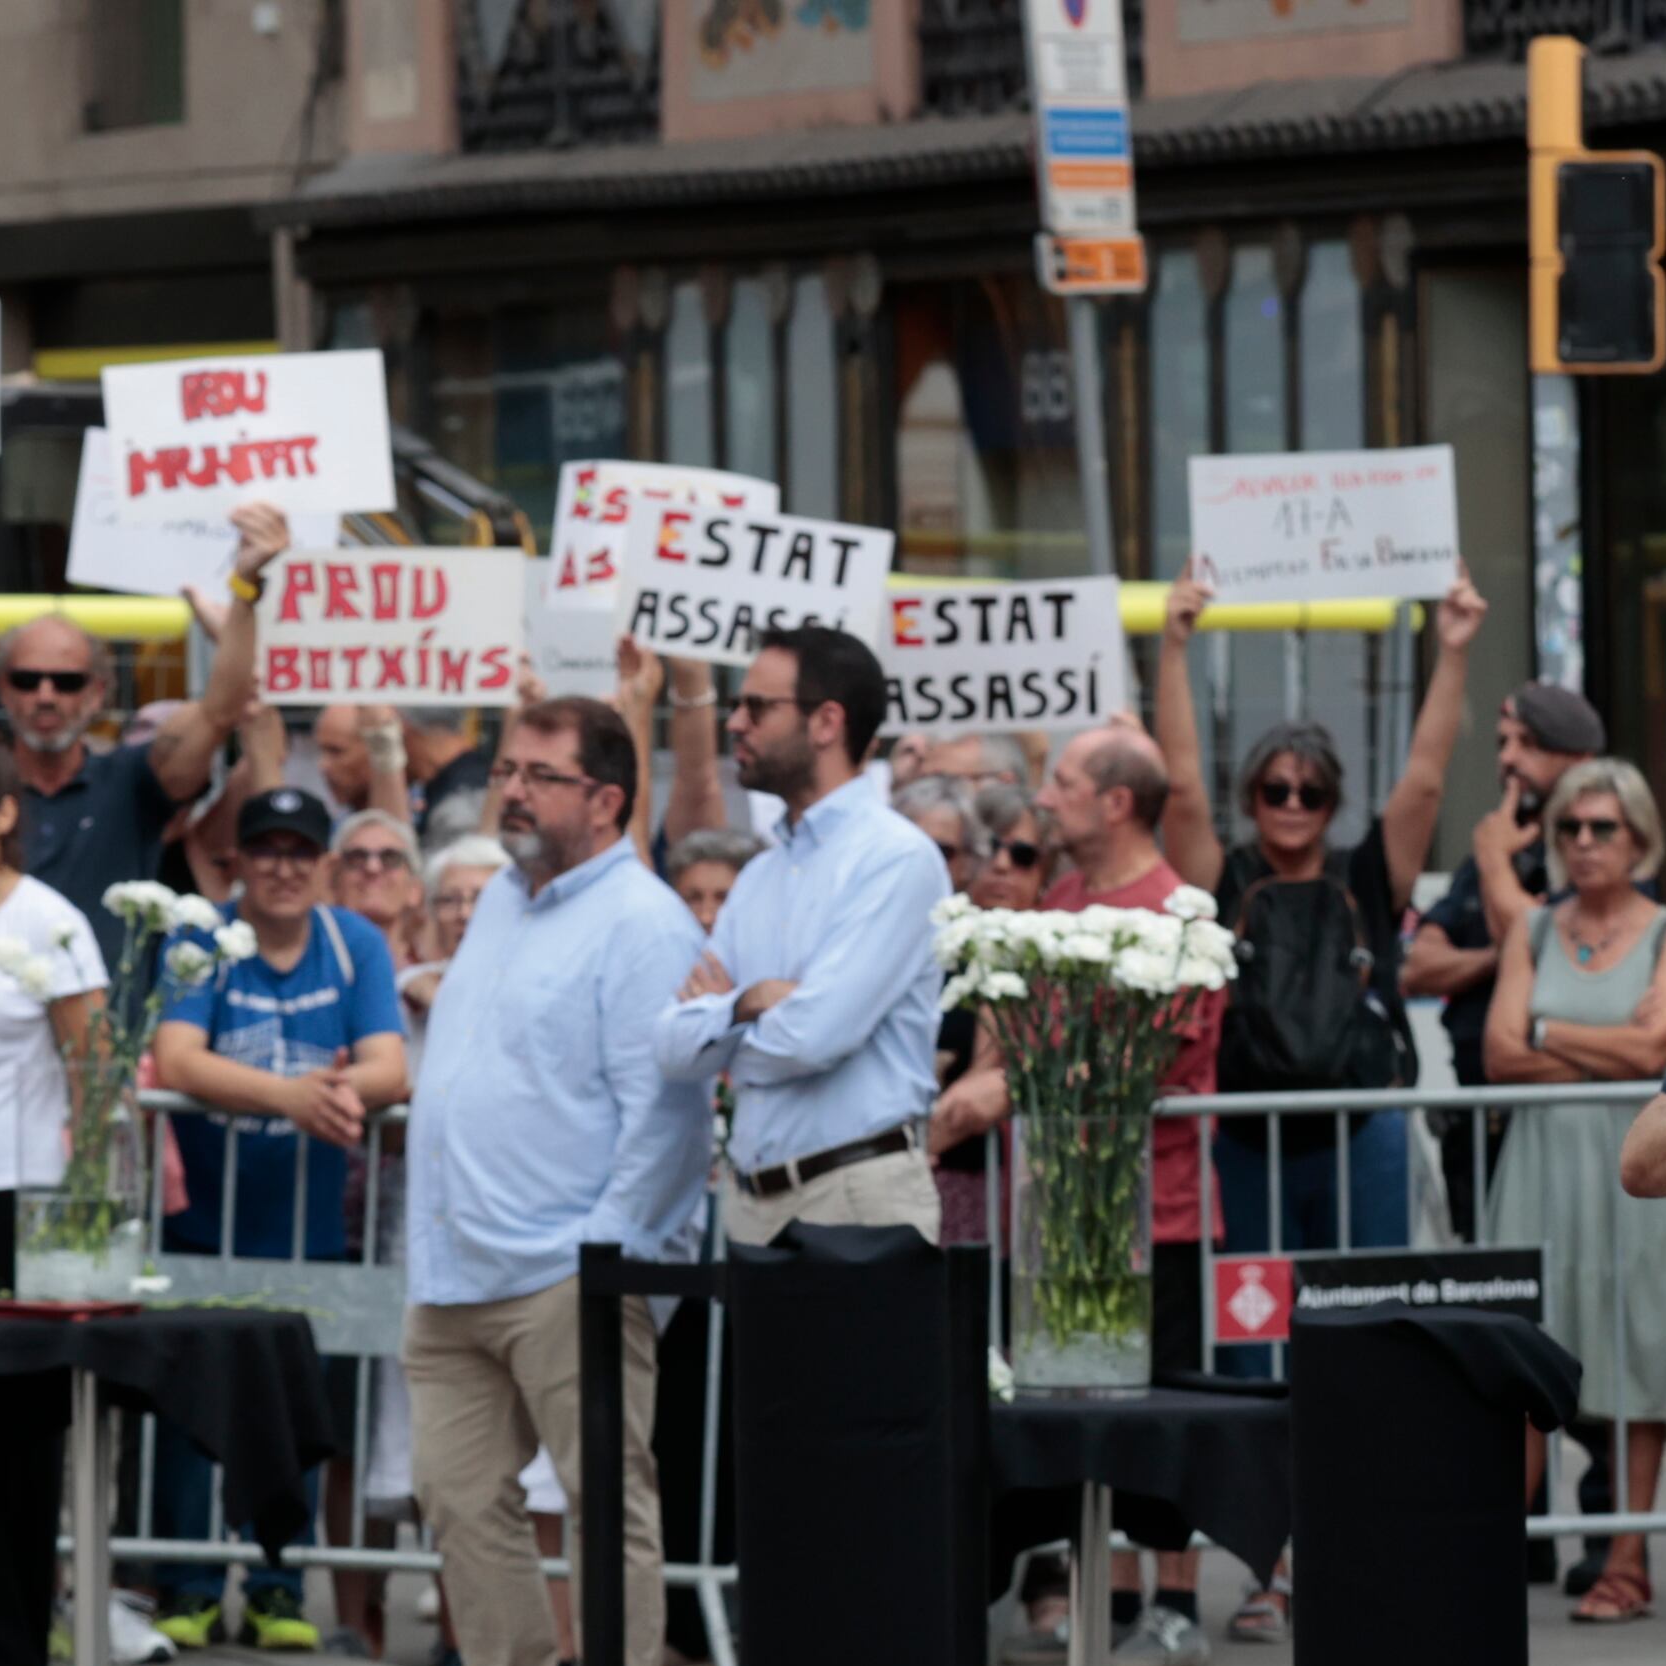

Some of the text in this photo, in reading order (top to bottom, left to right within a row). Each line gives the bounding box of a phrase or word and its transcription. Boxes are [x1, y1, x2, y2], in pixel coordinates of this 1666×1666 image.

[654, 510, 863, 587] ESTAT
[276, 562, 449, 623] PROU
[892, 593, 1075, 647] ESTAT
[266, 627, 513, 694] BOTXÍNS
[883, 652, 1102, 723] ASSASSÍ
[1297, 1276, 1540, 1309] Ajuntament de Barcelona
